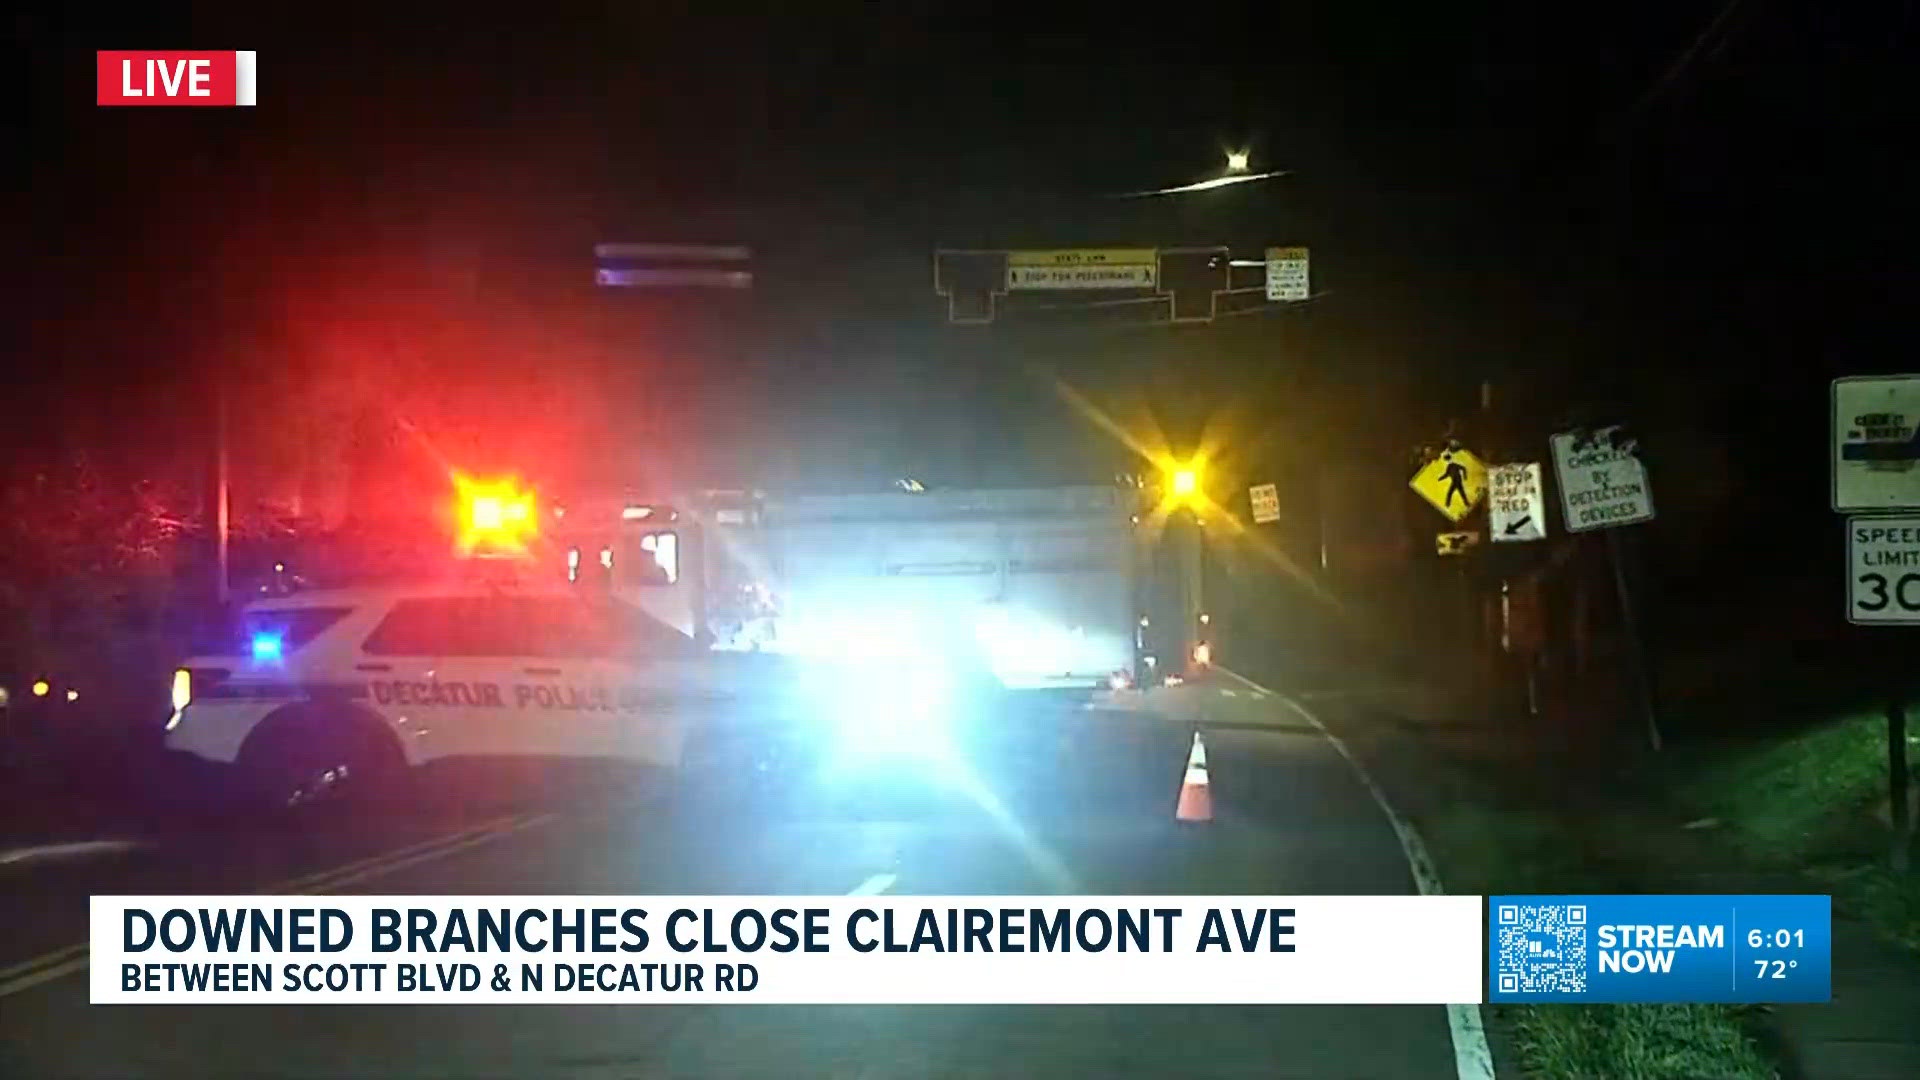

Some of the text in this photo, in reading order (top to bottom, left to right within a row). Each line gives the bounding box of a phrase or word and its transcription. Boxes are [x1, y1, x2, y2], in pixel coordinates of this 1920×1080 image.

[1495, 471, 1533, 486] STOP
[1592, 470, 1610, 484] BY
[1569, 484, 1642, 506] DETECTION
[1500, 498, 1530, 512] RED
[1579, 502, 1637, 523] DEVICES
[371, 680, 505, 708] DECATUR
